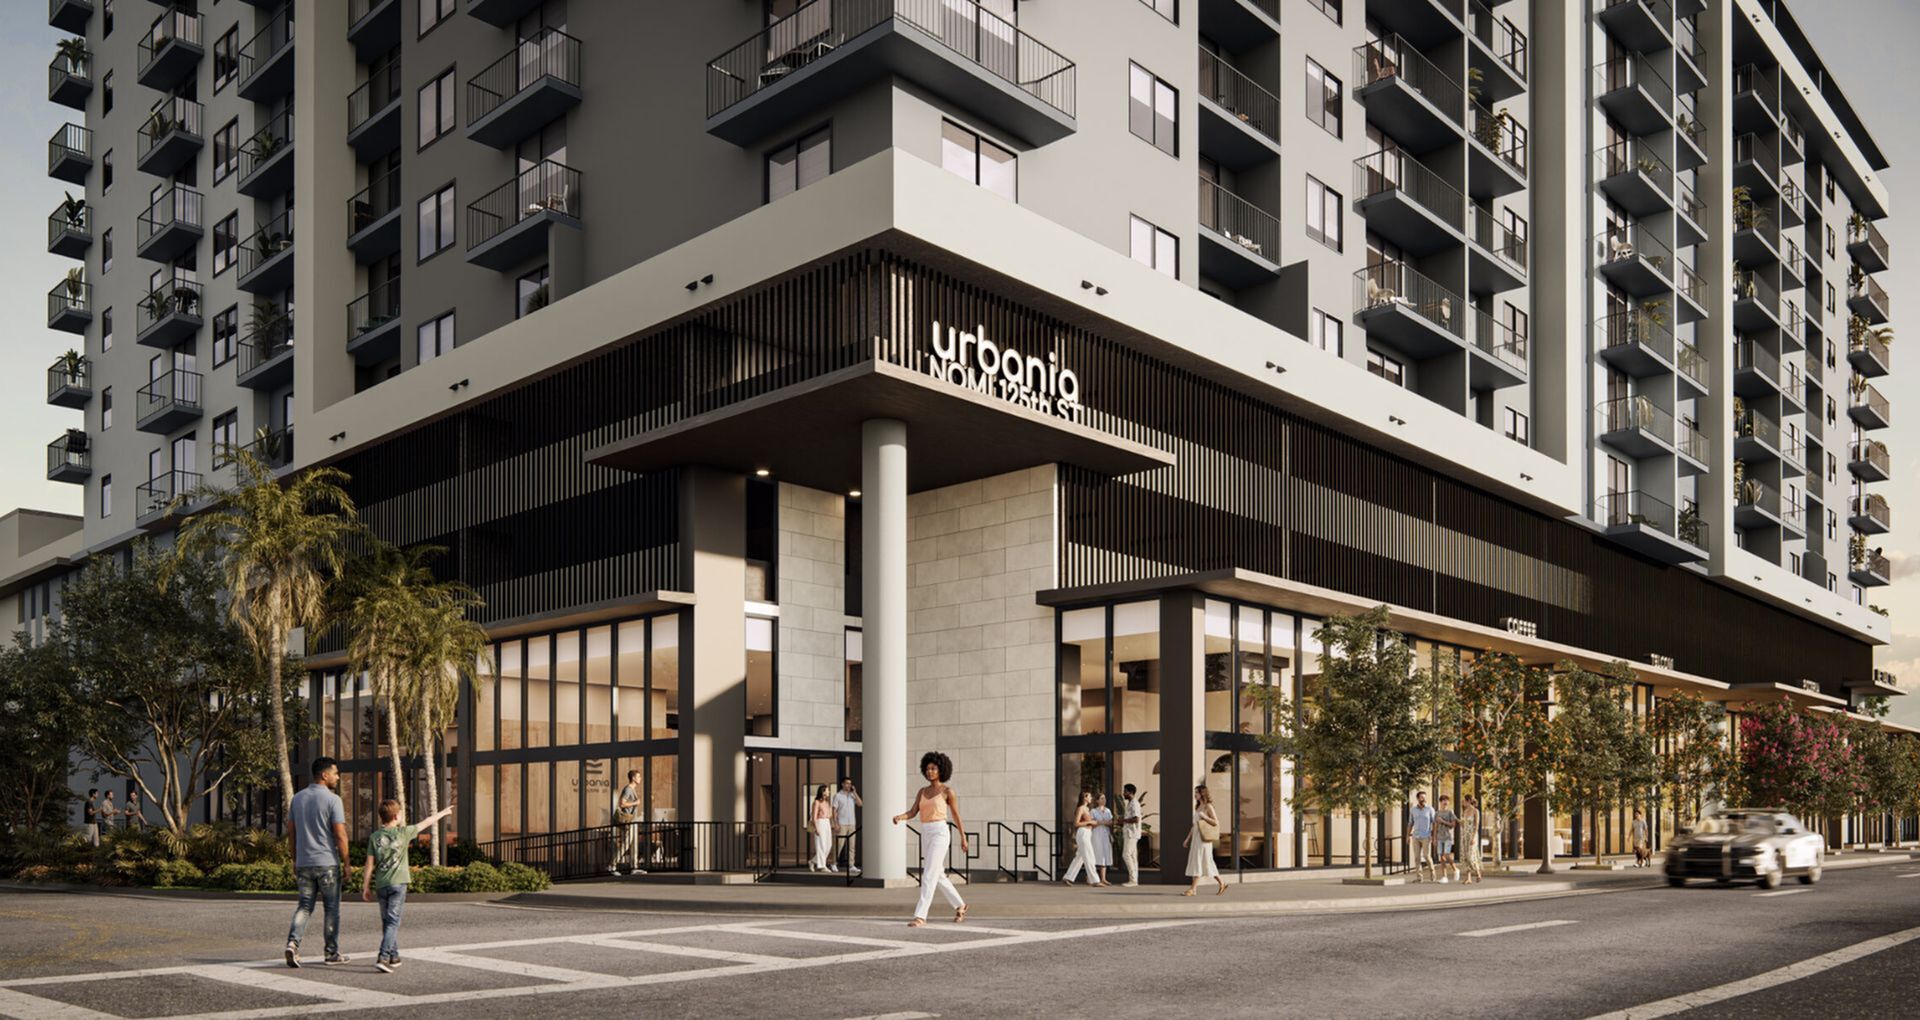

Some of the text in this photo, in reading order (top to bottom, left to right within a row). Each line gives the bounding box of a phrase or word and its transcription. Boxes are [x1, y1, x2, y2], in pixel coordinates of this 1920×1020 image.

[930, 354, 993, 397] NOMI
[999, 378, 1052, 415] 125th
[932, 320, 1079, 404] urbania
[1507, 616, 1537, 639] COFFEE
